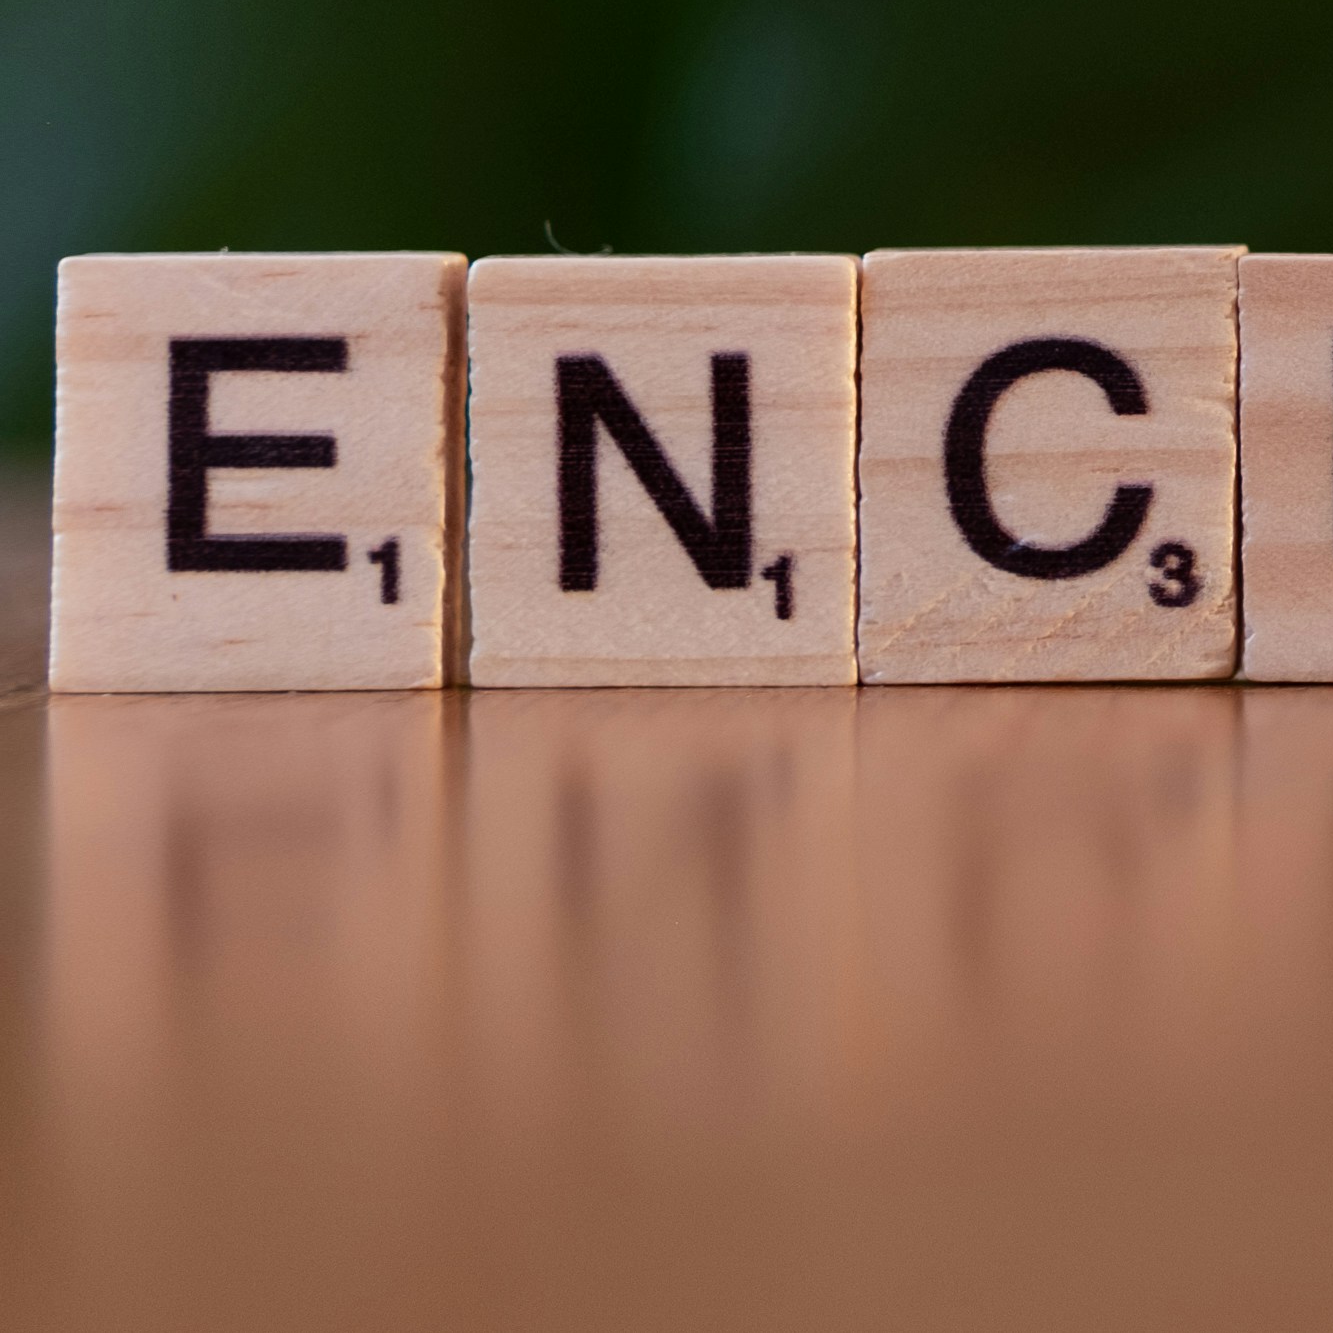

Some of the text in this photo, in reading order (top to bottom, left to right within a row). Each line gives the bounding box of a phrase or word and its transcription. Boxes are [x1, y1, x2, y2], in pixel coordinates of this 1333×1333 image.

[366, 537, 402, 605] 1
[758, 554, 795, 621] 1
[1148, 540, 1205, 609] 3
